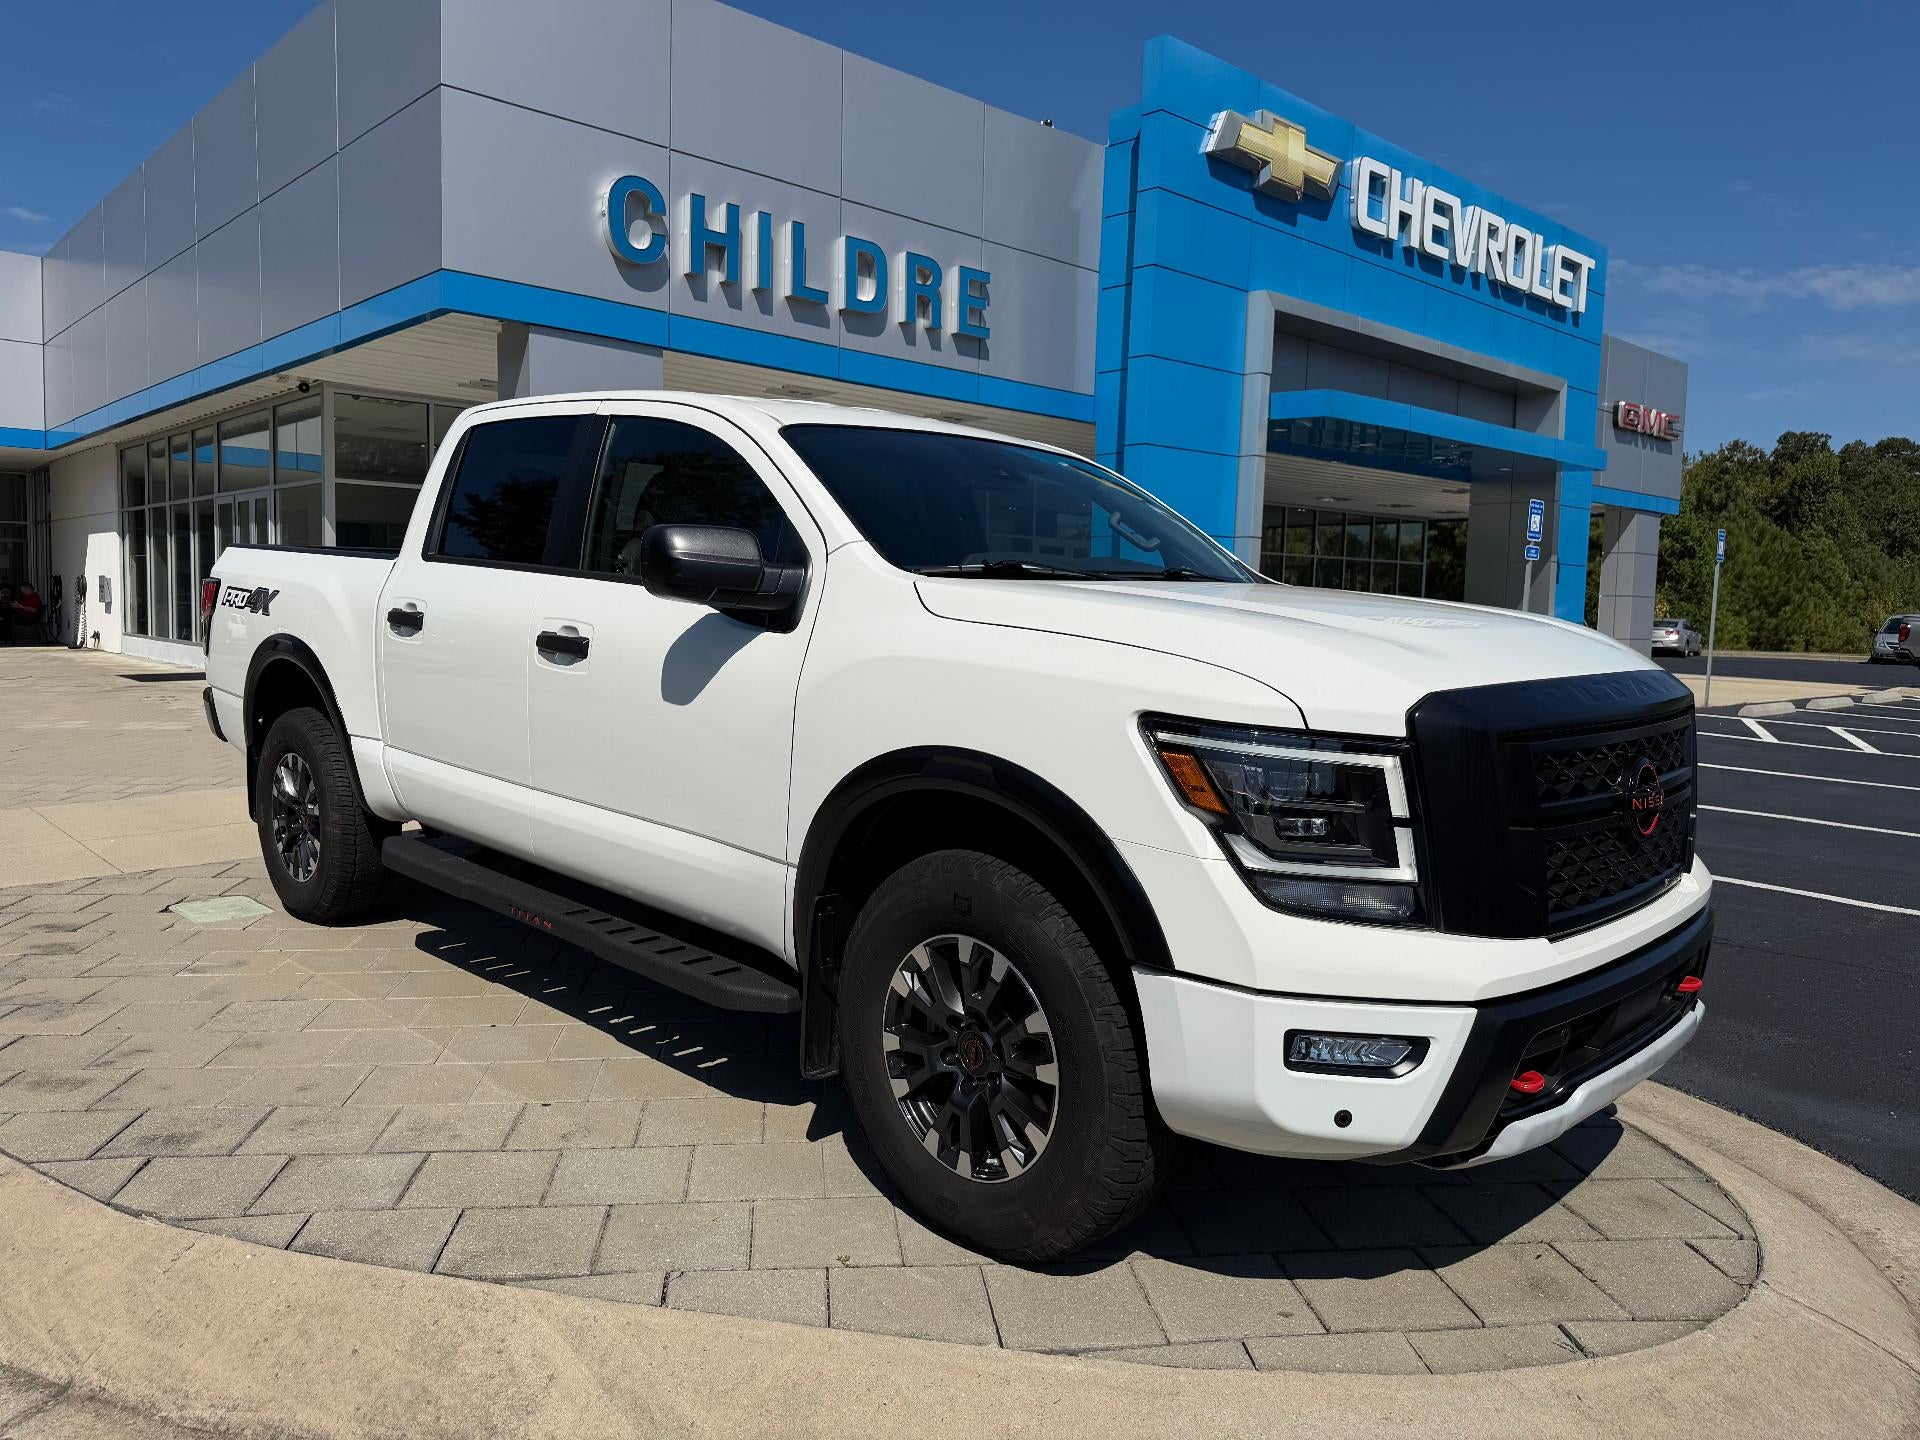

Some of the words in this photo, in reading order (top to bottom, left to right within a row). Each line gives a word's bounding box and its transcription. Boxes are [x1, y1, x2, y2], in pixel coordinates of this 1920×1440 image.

[604, 175, 991, 339] CHILDRE
[1352, 156, 1596, 313] CHEVROLET
[1617, 401, 1680, 439] GMC
